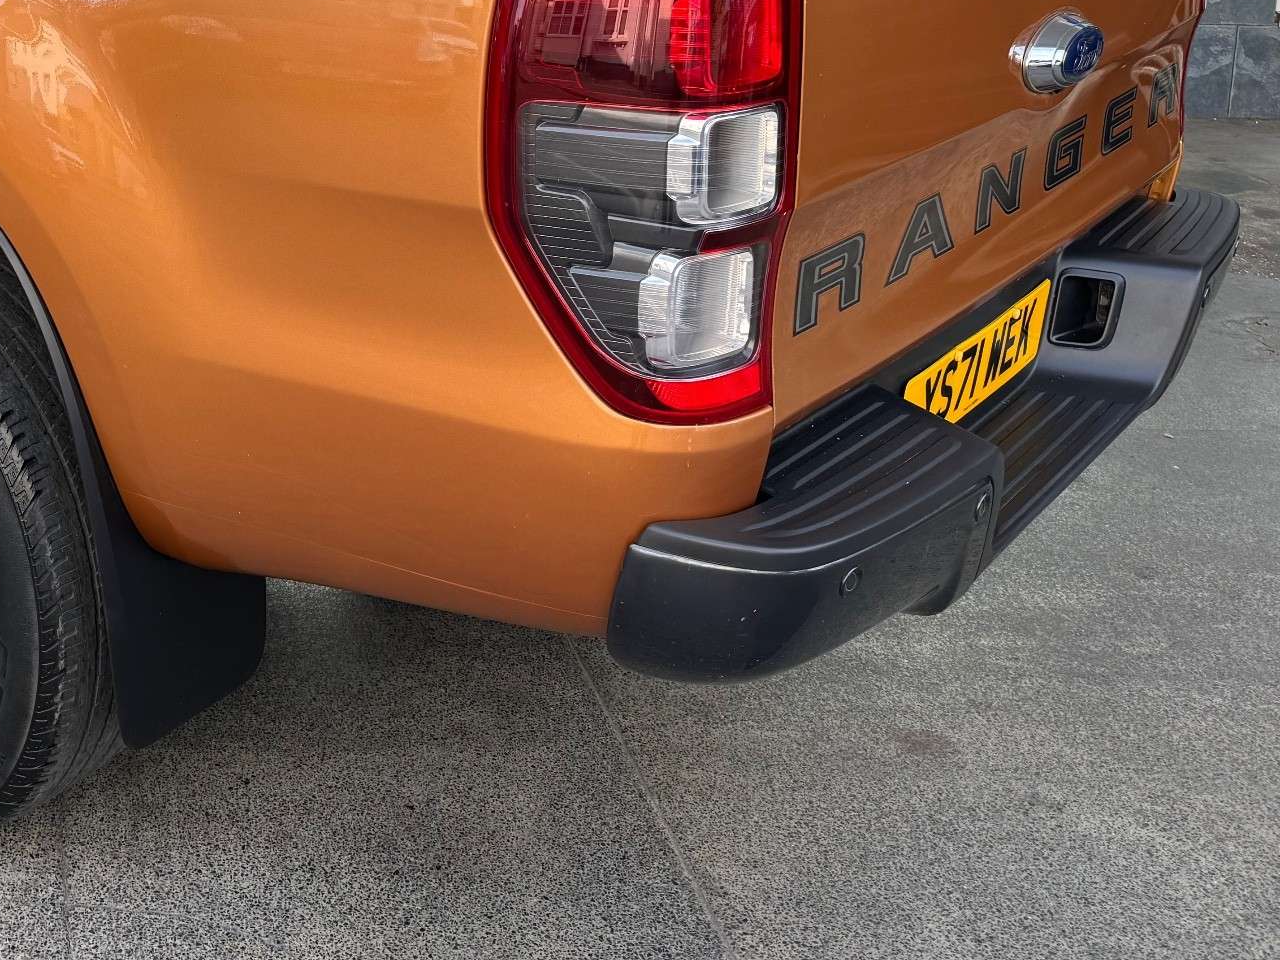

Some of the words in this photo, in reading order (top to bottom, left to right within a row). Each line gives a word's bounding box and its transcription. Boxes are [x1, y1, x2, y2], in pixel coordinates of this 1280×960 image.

[793, 62, 1179, 337] RANGER
[925, 338, 985, 418] YS71
[983, 297, 1038, 388] WEK
